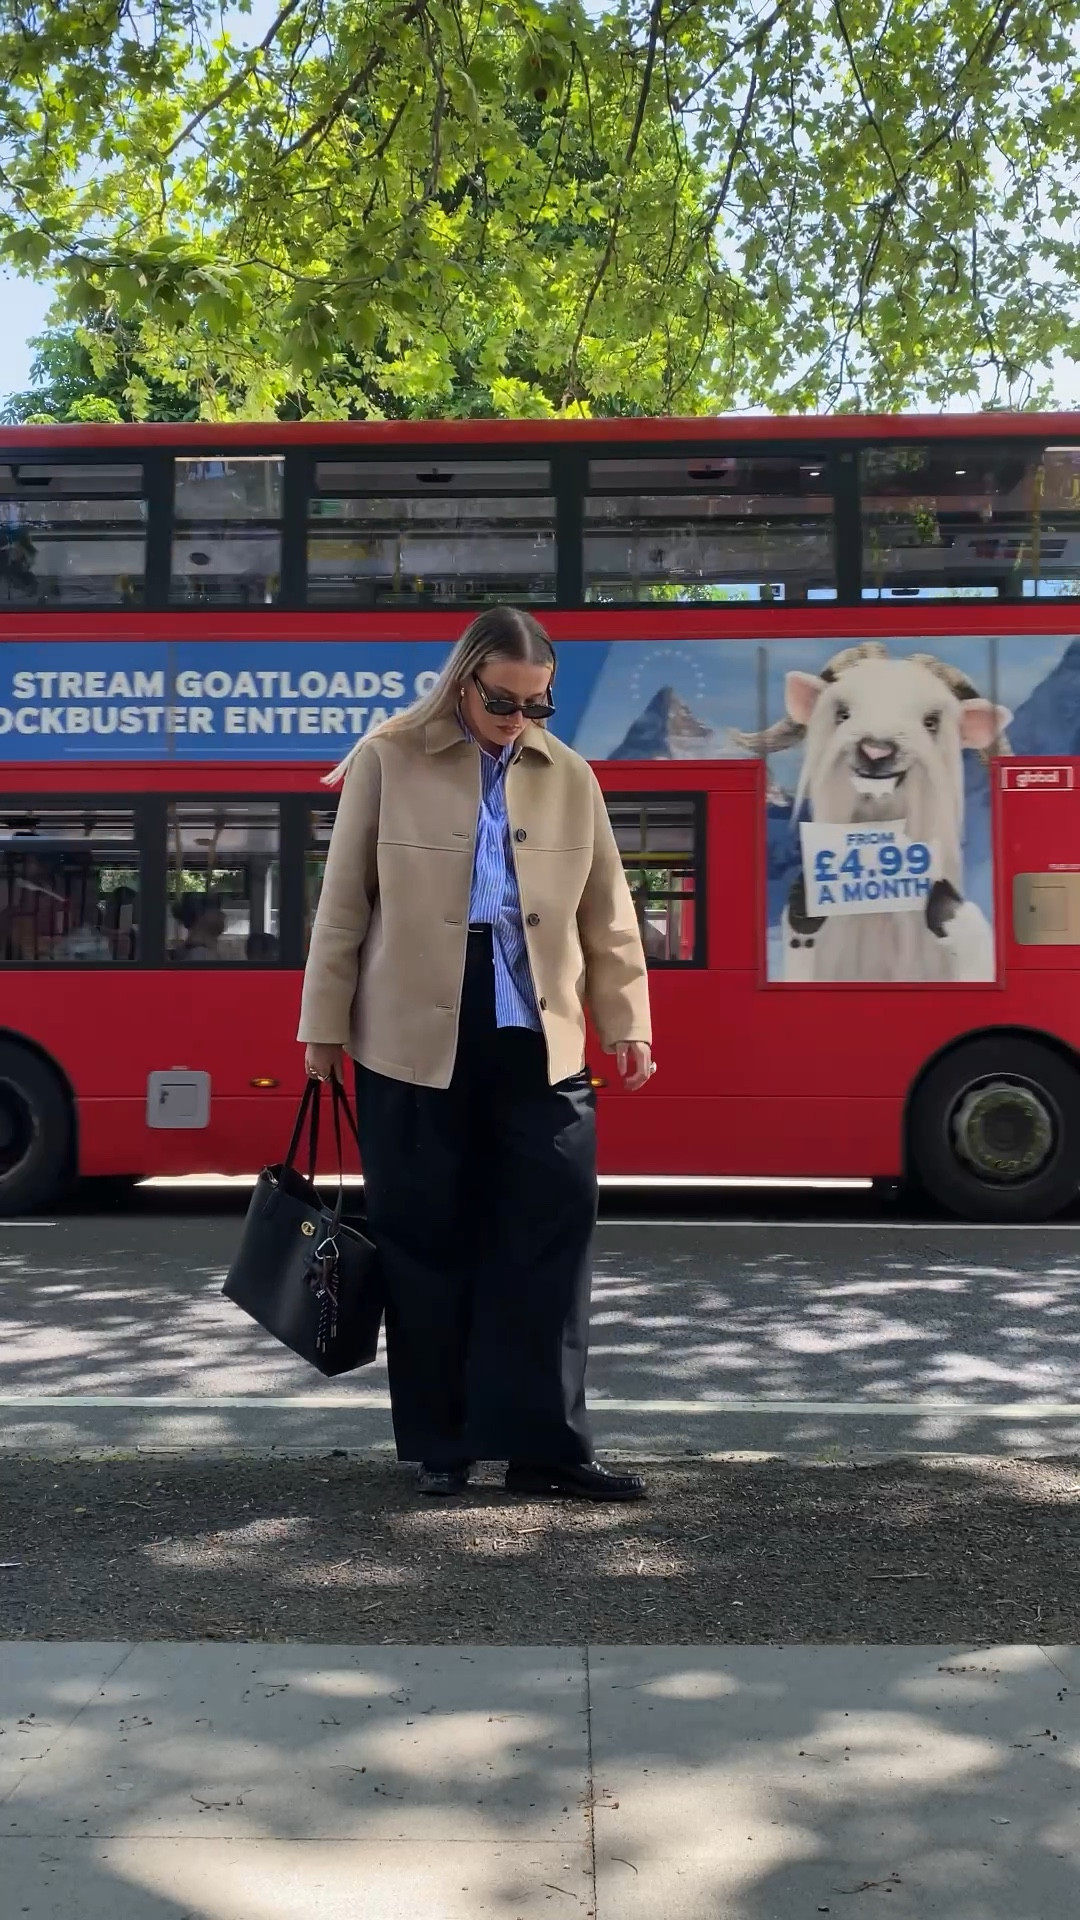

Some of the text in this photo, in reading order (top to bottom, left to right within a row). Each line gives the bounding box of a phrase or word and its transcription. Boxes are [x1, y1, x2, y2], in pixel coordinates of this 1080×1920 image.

[12, 671, 164, 698] STREAM
[175, 671, 405, 699] GOATLOADS
[1016, 770, 1060, 788] global
[846, 832, 895, 846] FROM
[815, 844, 931, 882] £4.99
[819, 878, 930, 905] A MONTH
